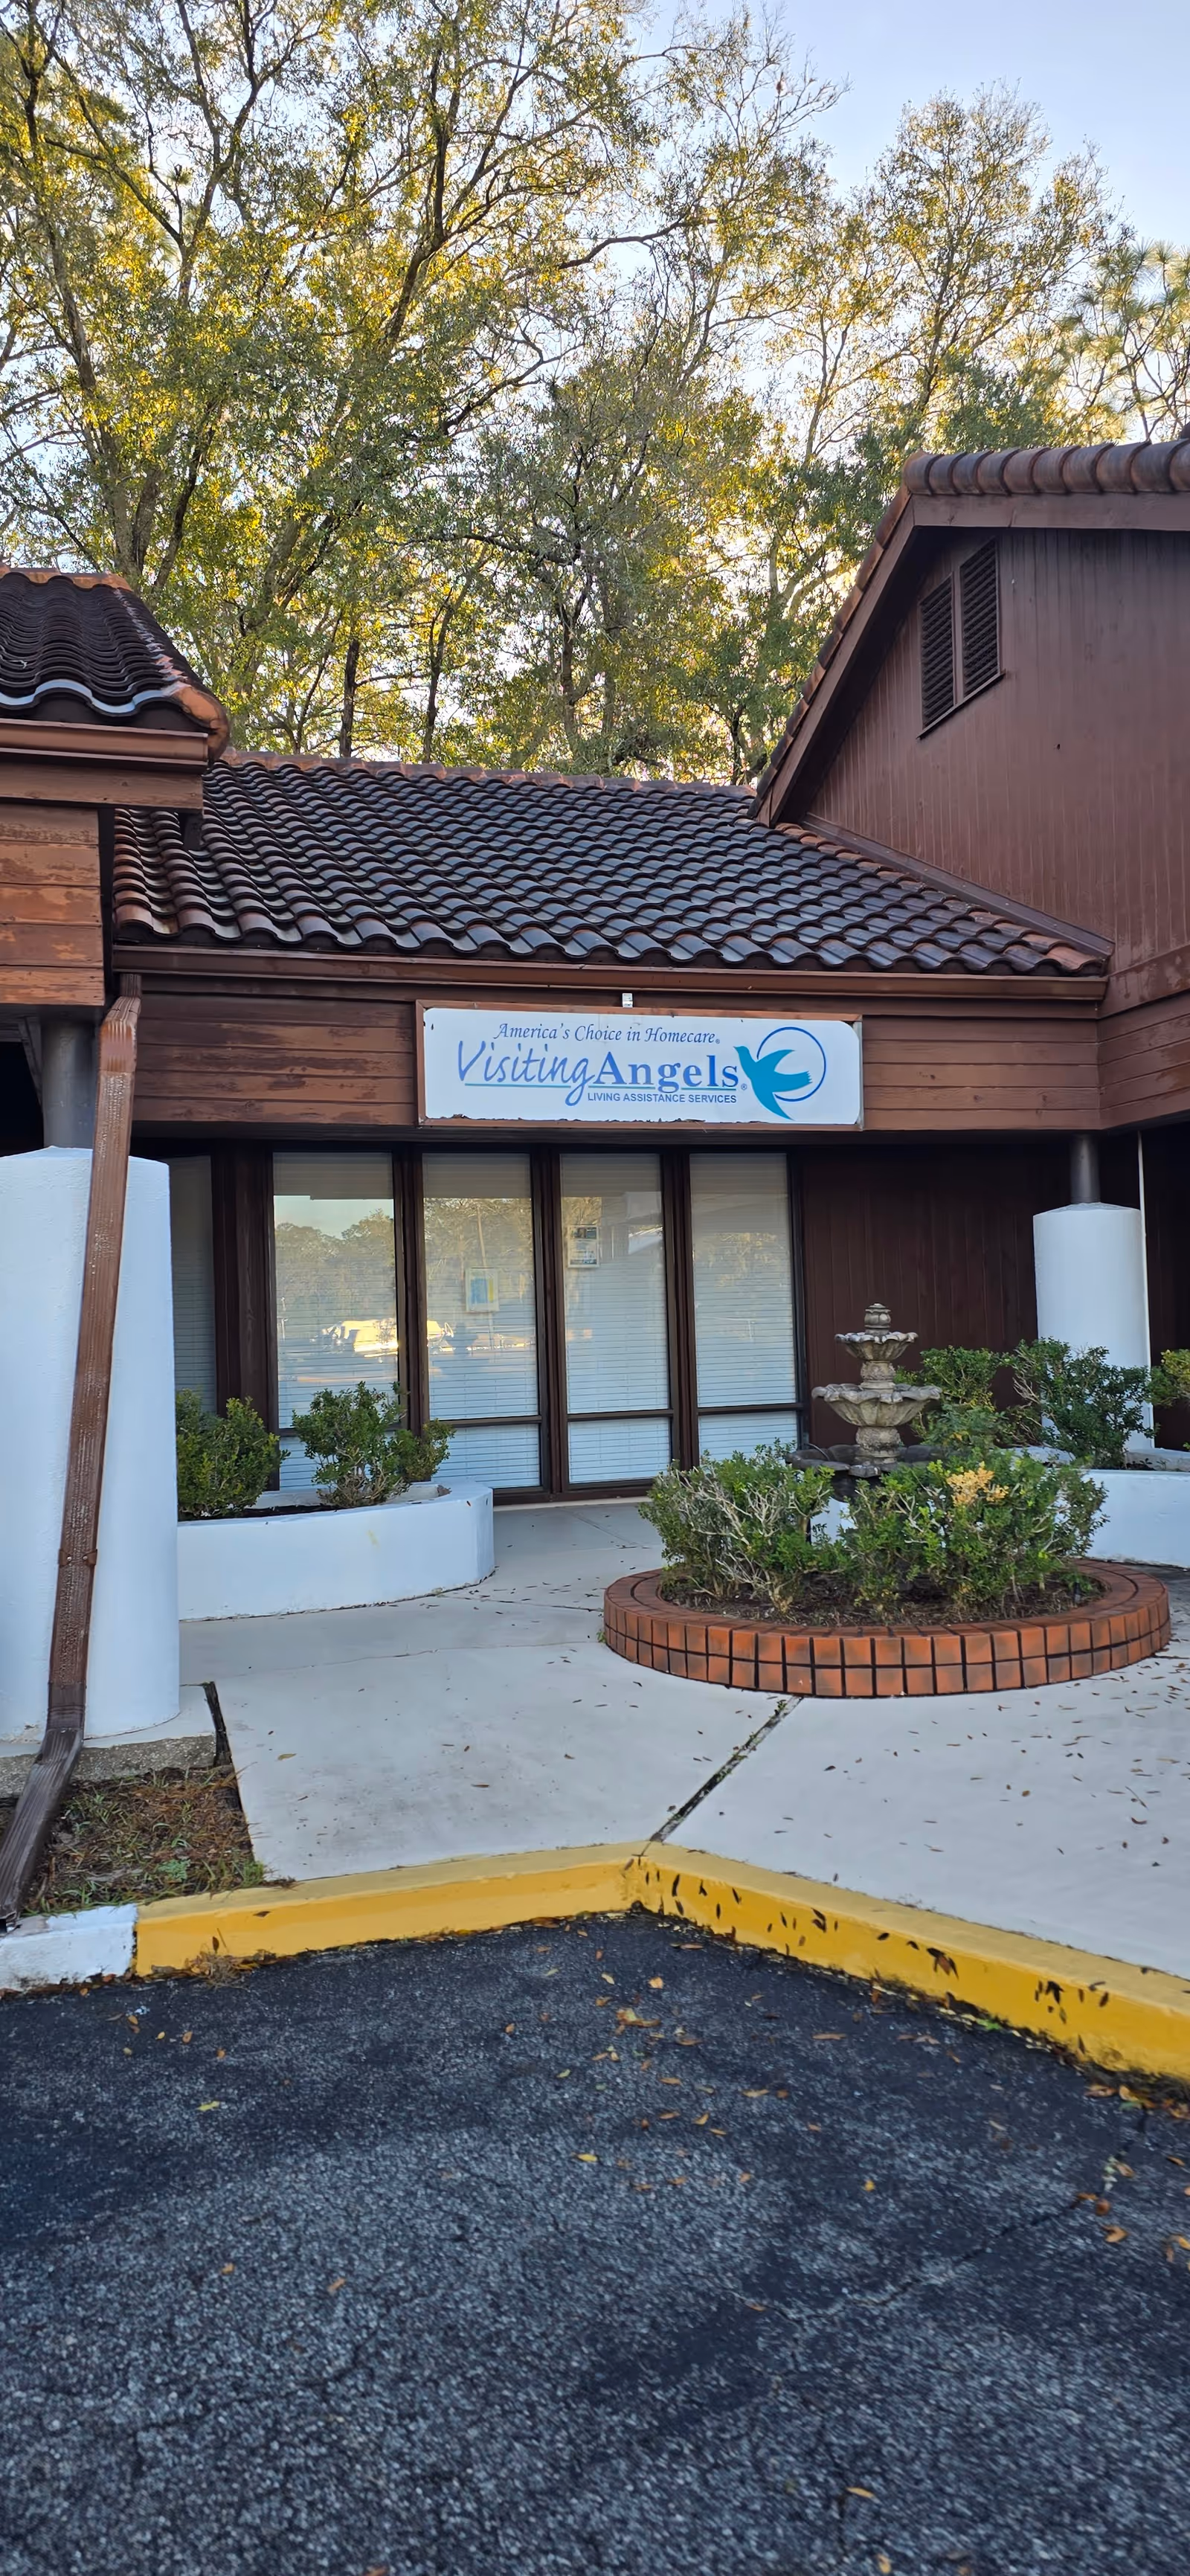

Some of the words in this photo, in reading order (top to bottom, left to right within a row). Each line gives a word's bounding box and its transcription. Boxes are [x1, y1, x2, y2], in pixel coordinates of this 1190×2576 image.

[574, 1024, 622, 1041] Choice
[627, 1027, 640, 1041] in
[458, 1040, 595, 1106] Visiting
[588, 1092, 621, 1102] LIVING
[623, 1093, 686, 1103] ASSISTANCE
[688, 1094, 737, 1104] SERVICES
